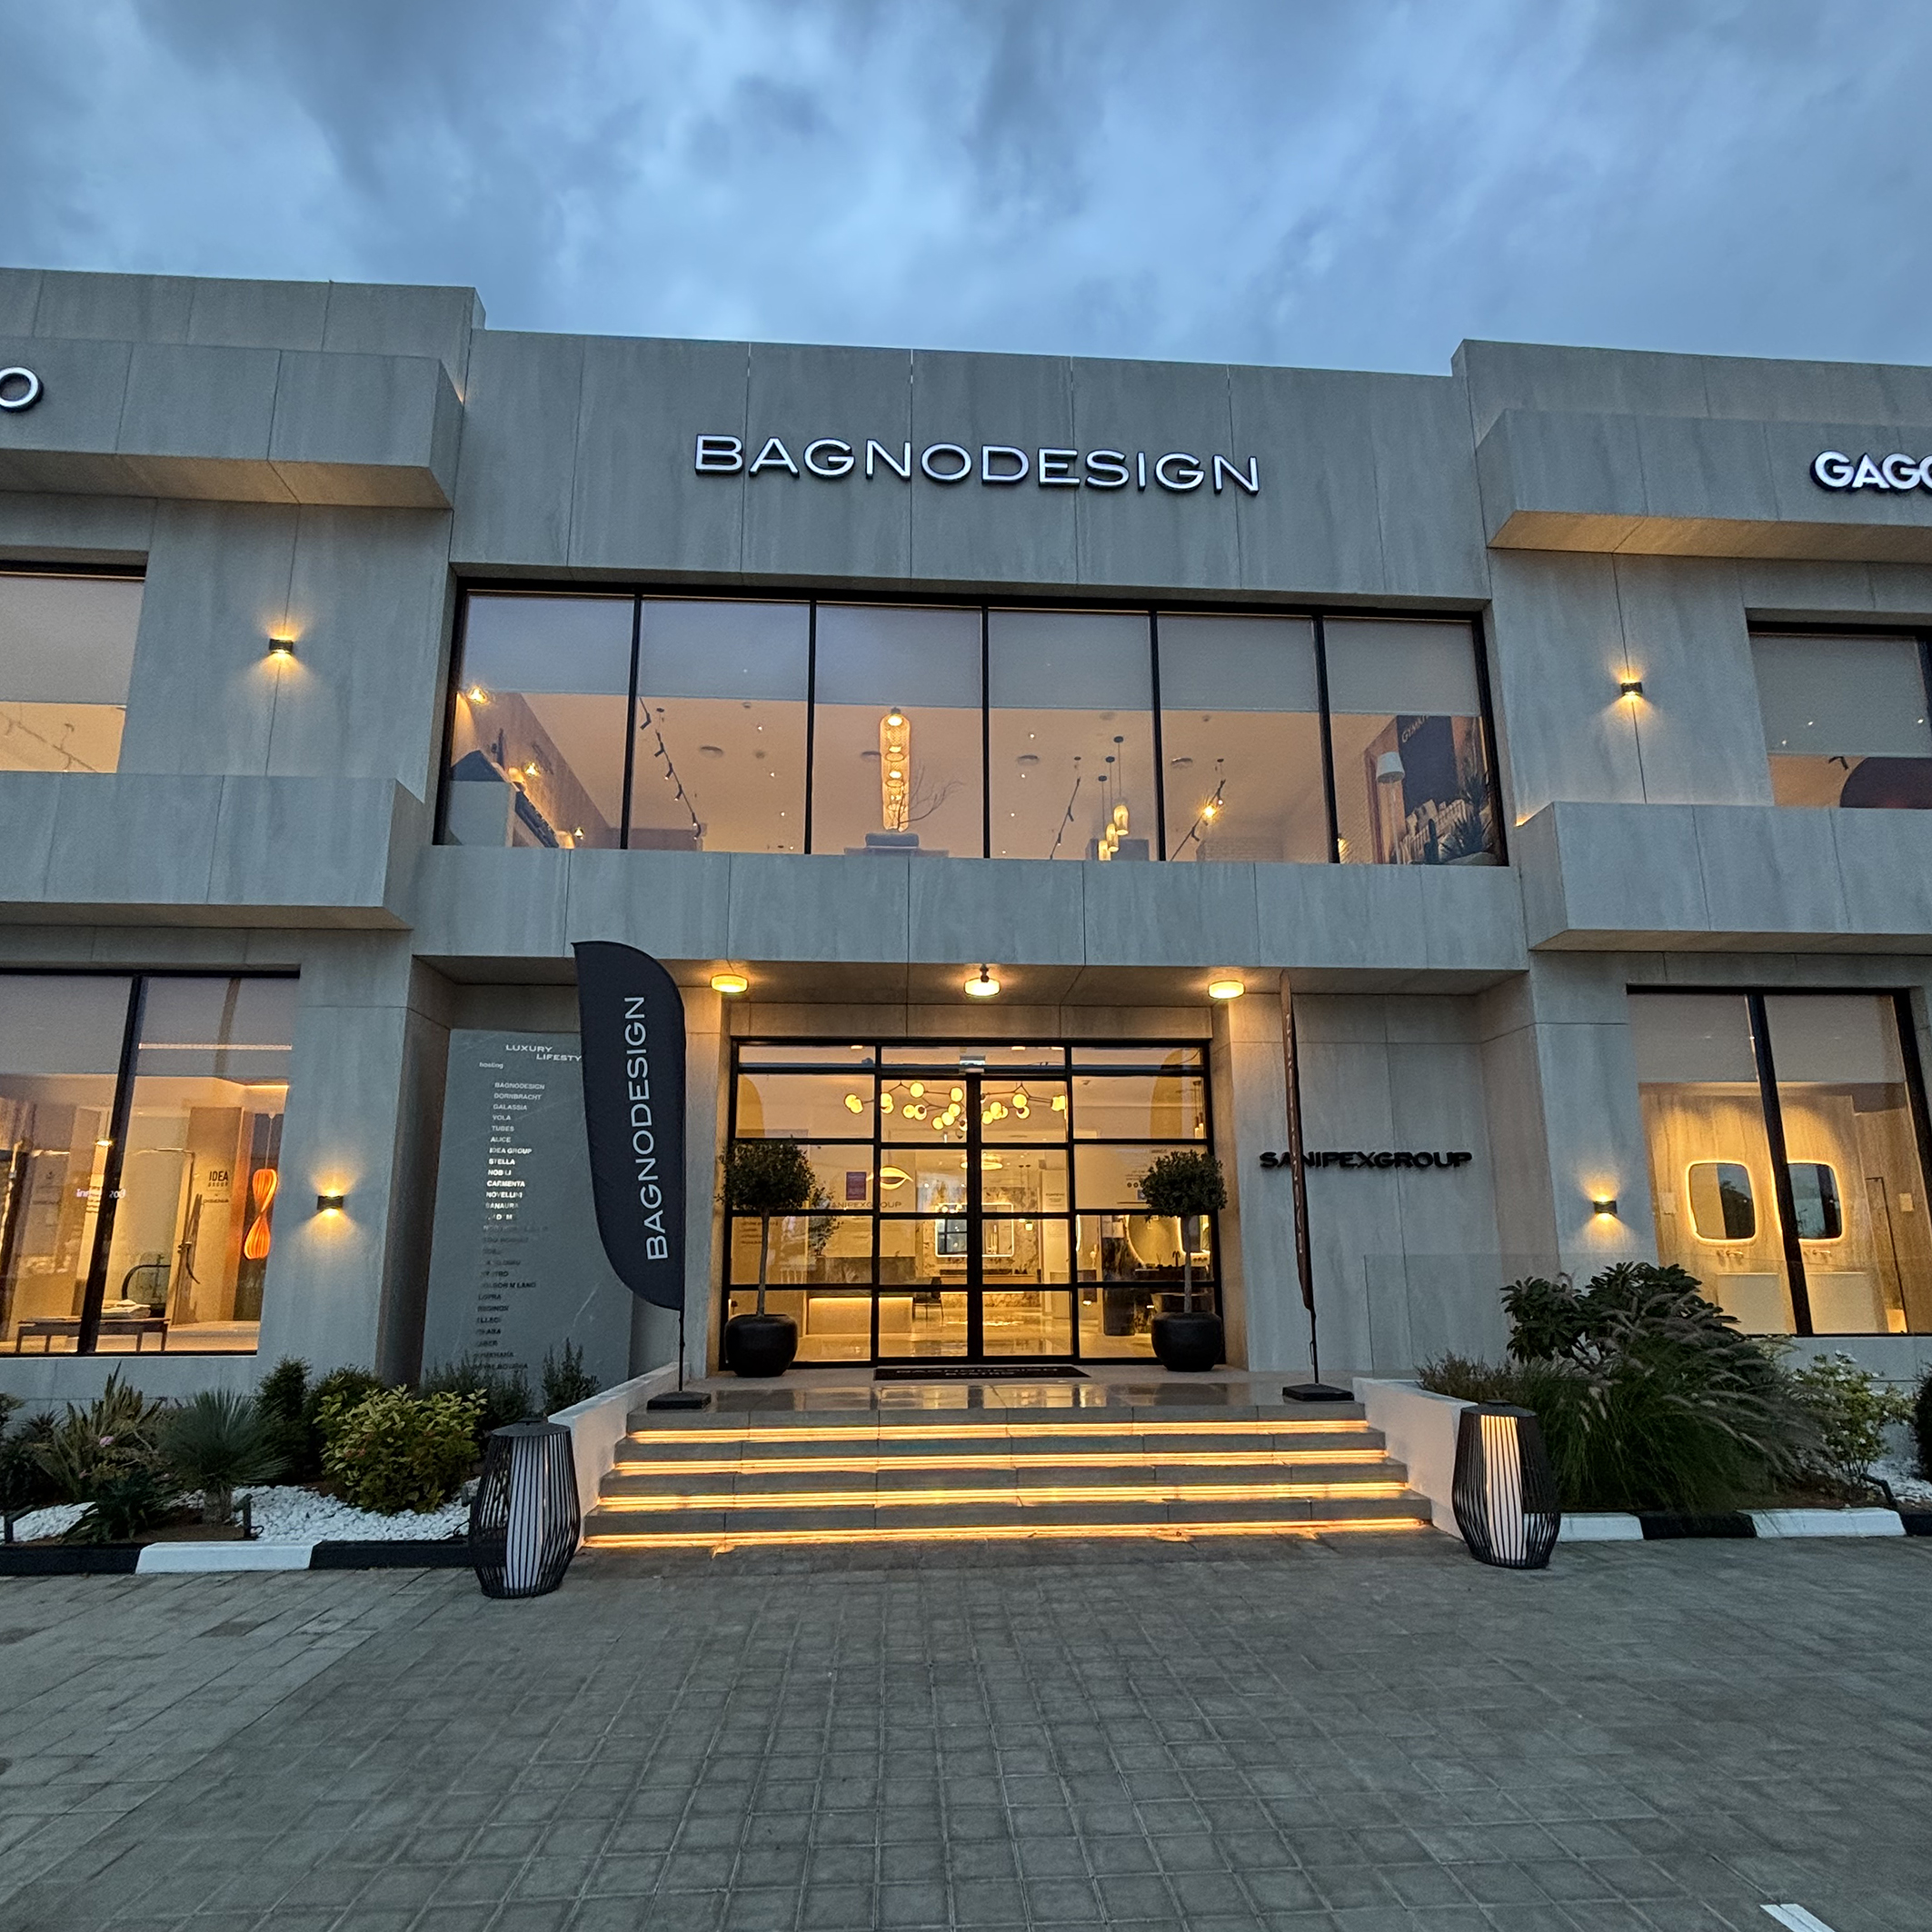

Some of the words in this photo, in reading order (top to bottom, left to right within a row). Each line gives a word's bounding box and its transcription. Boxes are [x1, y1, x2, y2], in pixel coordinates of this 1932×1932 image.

[695, 434, 1260, 494] BAGNODESIGN
[505, 1044, 553, 1052] LUXURY
[494, 1081, 545, 1090] BAGNODESIGN
[493, 1092, 542, 1100] DORNBRACHT
[623, 996, 669, 1260] BAGNODESIGN
[209, 1170, 229, 1181] IDEA
